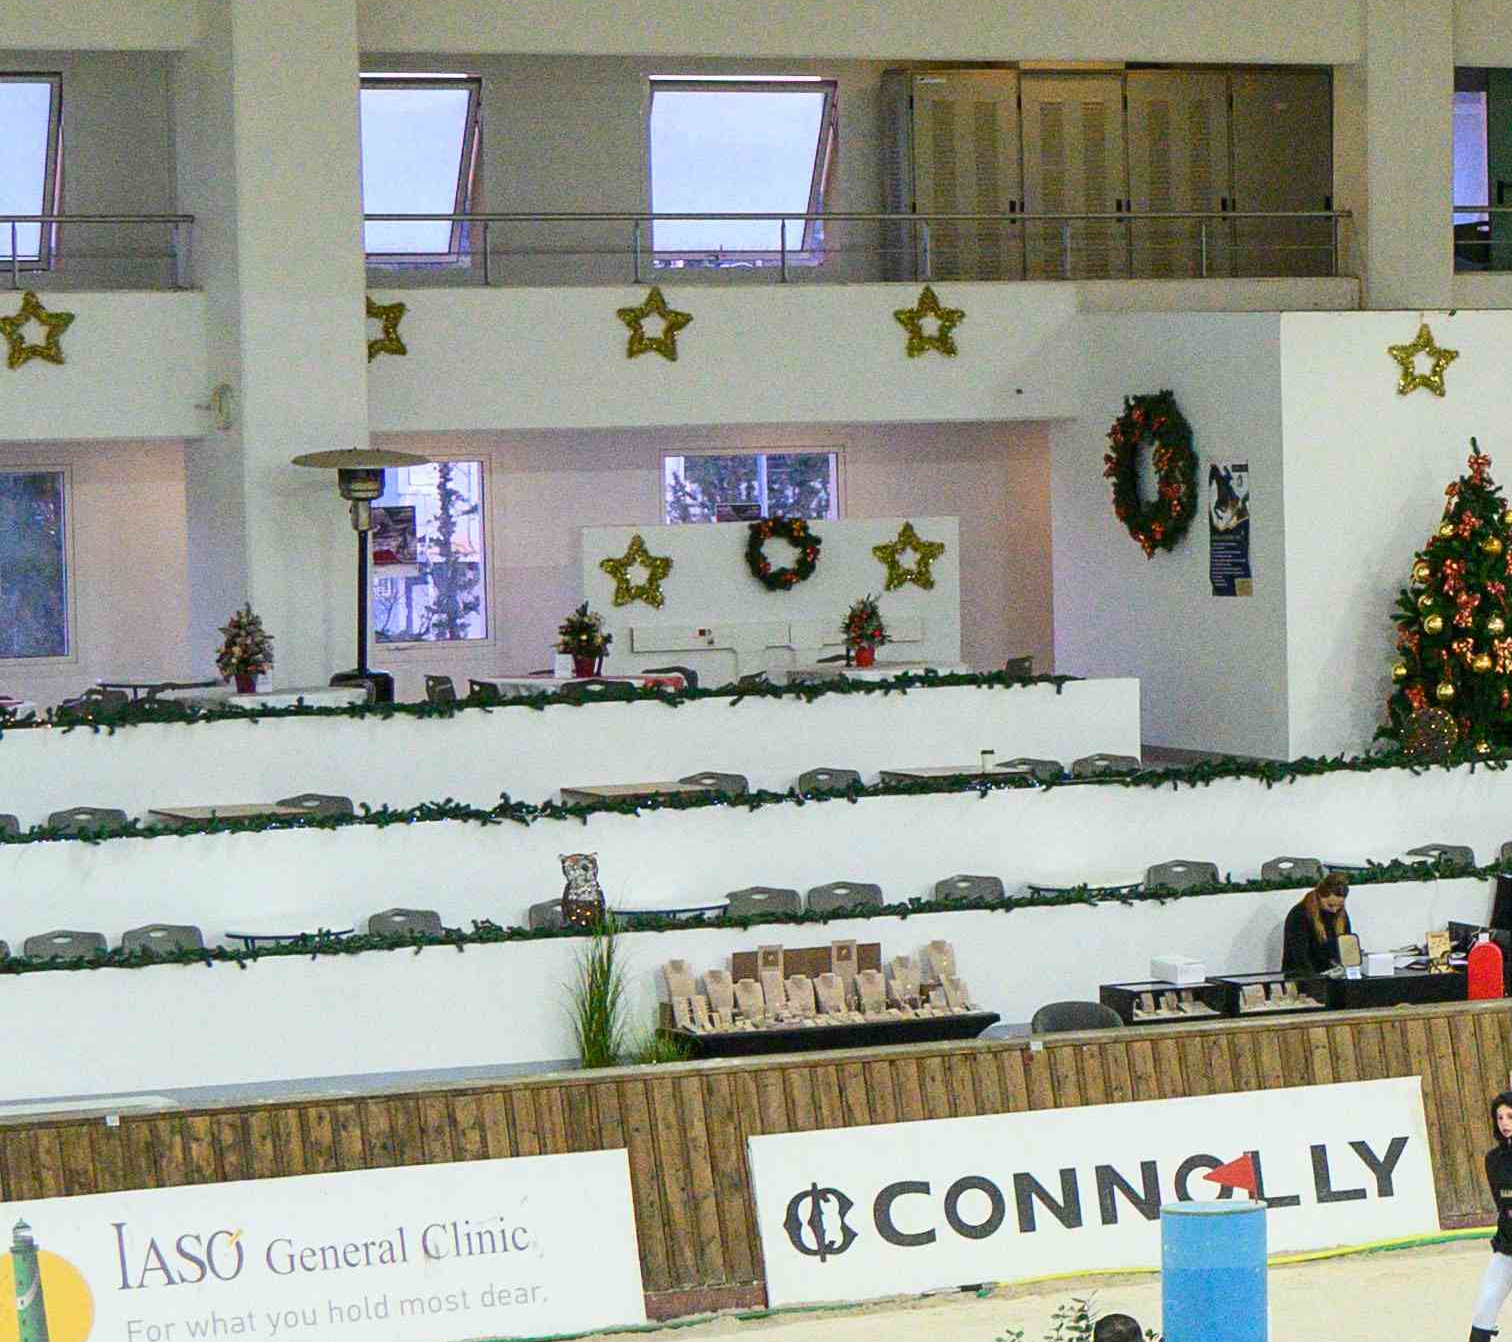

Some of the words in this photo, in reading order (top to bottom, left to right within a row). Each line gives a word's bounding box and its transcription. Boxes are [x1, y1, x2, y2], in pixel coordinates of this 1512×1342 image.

[873, 1135, 1410, 1249] CONNOLLY
[266, 1226, 409, 1276] General
[421, 1215, 531, 1261] Clinic
[185, 1310, 257, 1339] what
[266, 1302, 319, 1336] you
[328, 1293, 389, 1324] hold
[400, 1288, 470, 1317] most
[480, 1282, 549, 1309] dear.
